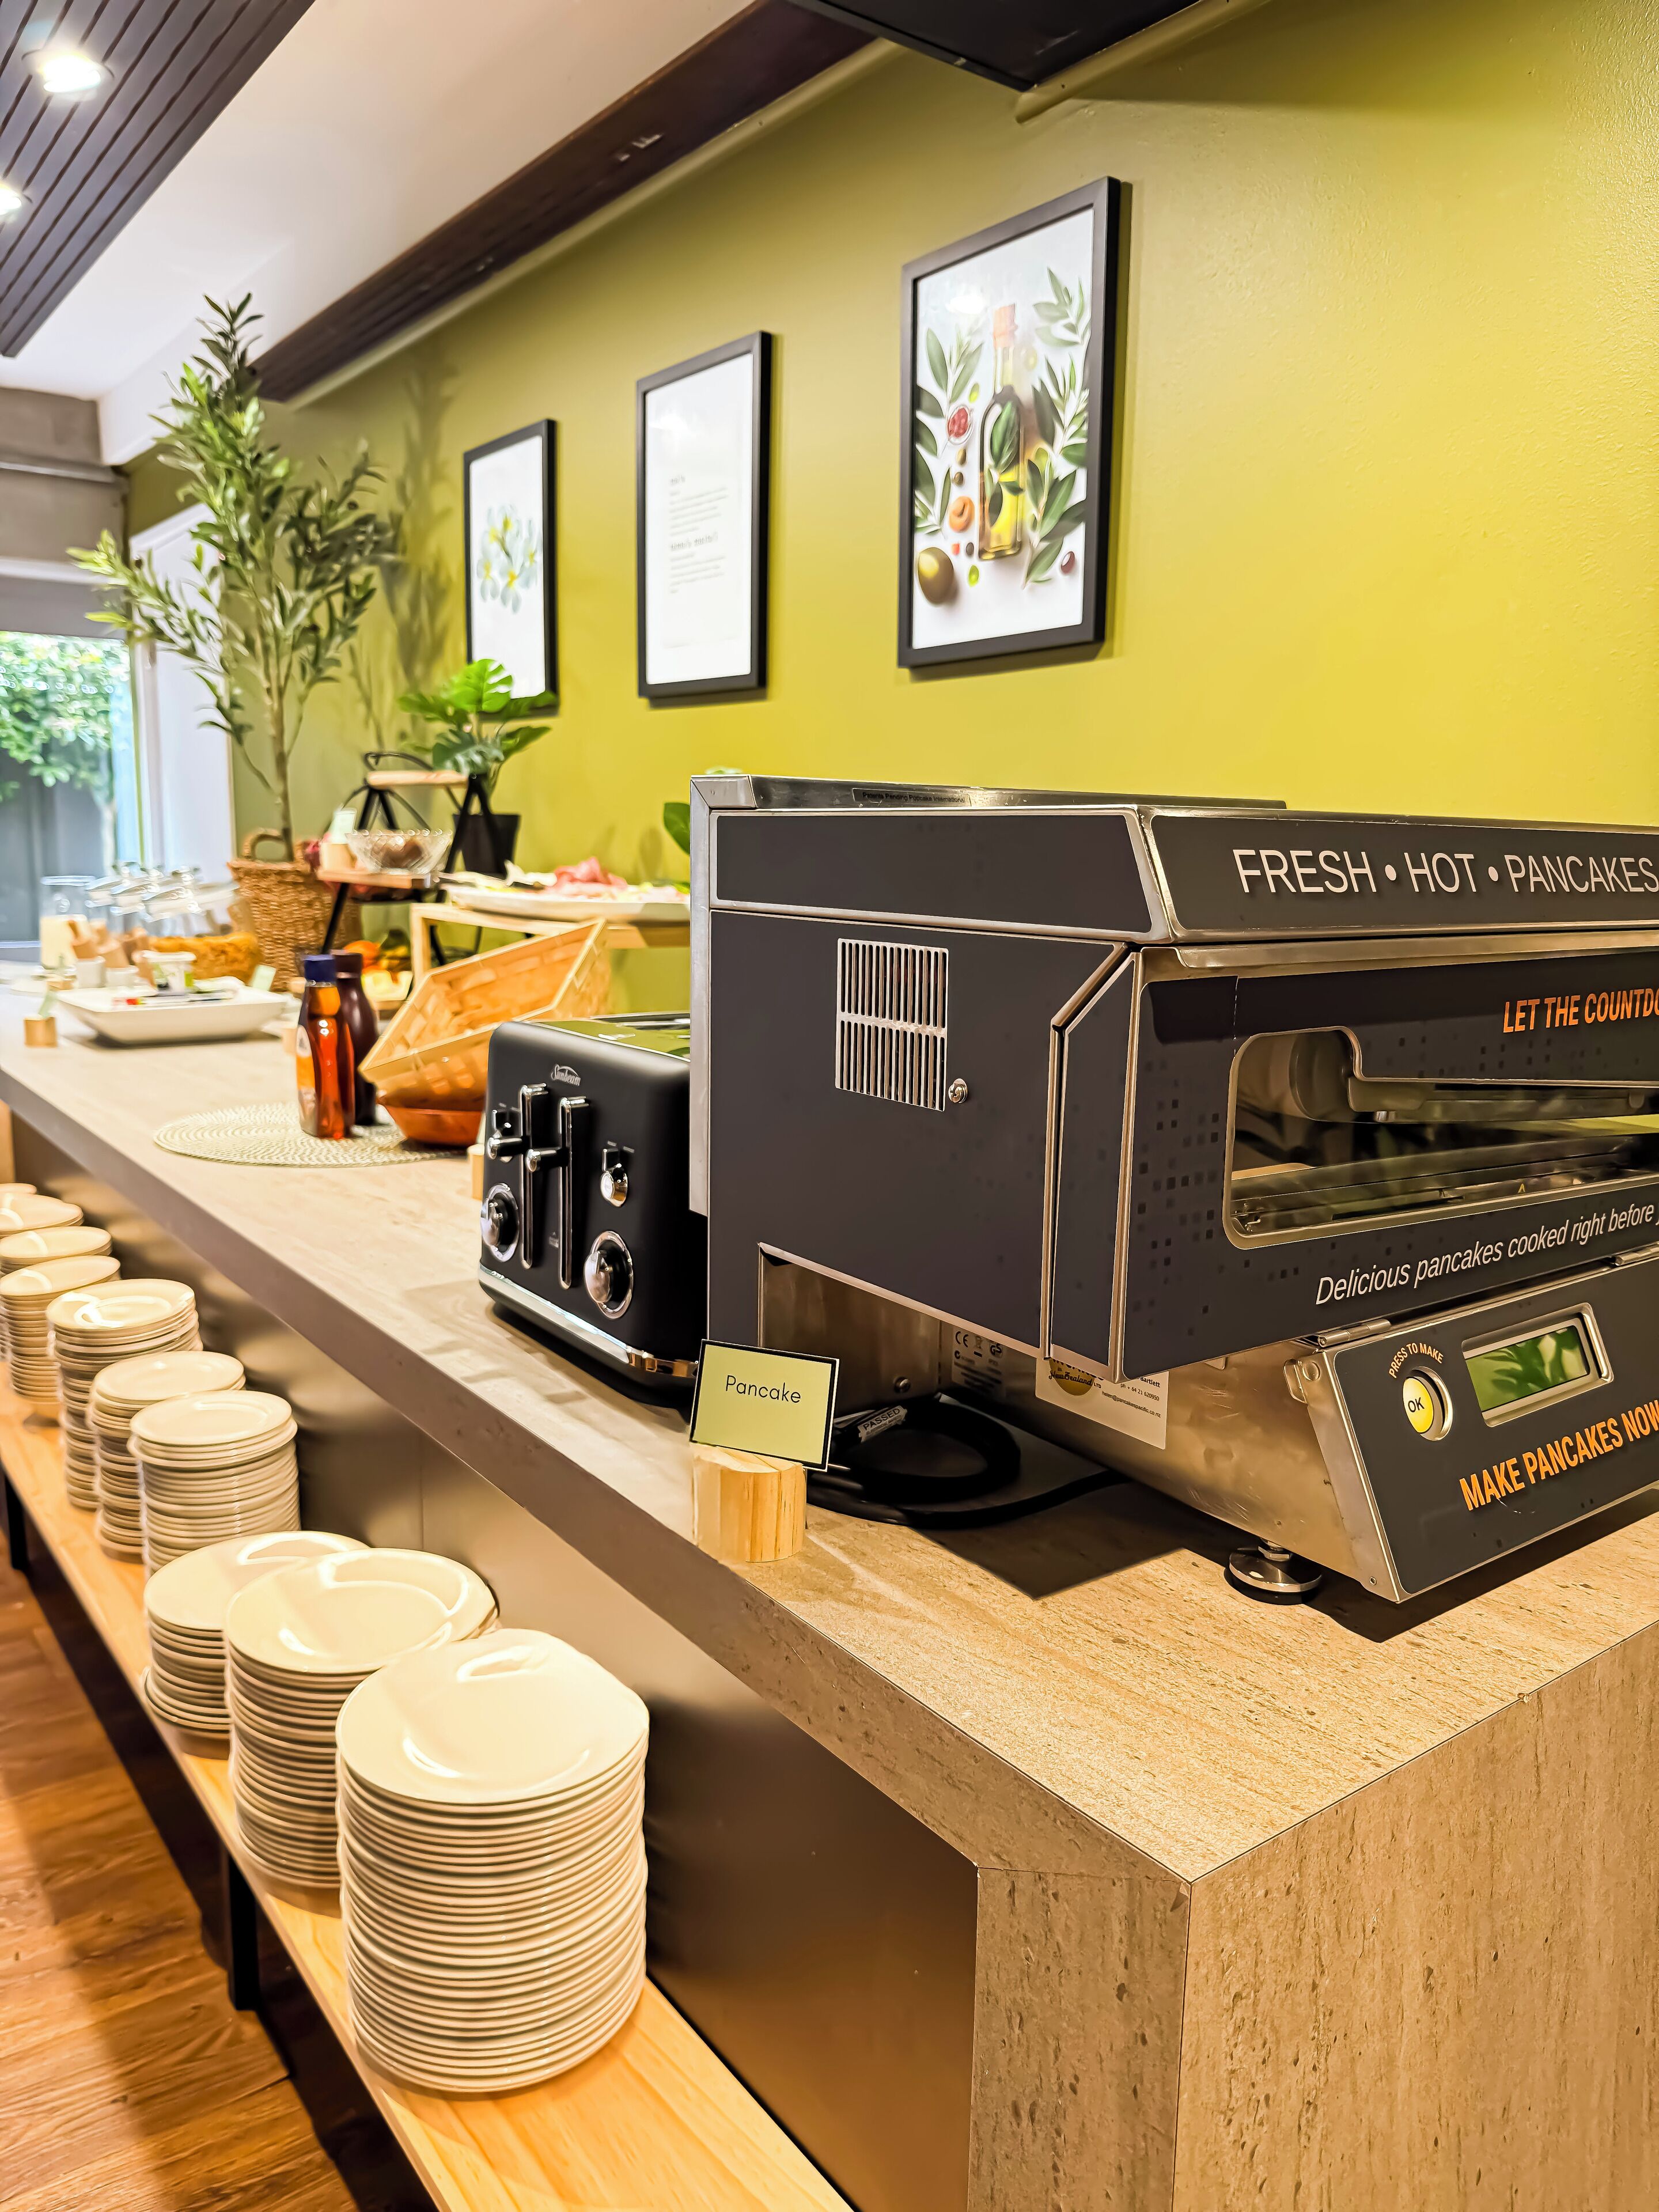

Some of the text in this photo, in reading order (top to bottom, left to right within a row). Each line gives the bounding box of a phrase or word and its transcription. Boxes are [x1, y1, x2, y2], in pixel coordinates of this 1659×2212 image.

[933, 795, 965, 804] International
[1233, 849, 1659, 893] FRESH HOT PANCAKES
[1503, 999, 1540, 1033] LET
[1544, 995, 1580, 1029] THE
[551, 1064, 581, 1086] Sunbeam
[1316, 1262, 1411, 1305] Delicious
[1414, 1241, 1503, 1289] pancakes
[1508, 1219, 1569, 1258] cooked
[1570, 1212, 1606, 1245] right
[1608, 1203, 1654, 1232] before
[1388, 1342, 1444, 1378] PRESS TO MAKE
[725, 1374, 801, 1404] Pancake
[1065, 1371, 1093, 1386] Zealand
[863, 1407, 900, 1431] PASSED
[1407, 1397, 1425, 1413] OK
[1459, 1399, 1659, 1512] MAKE PANCAKES NOW
